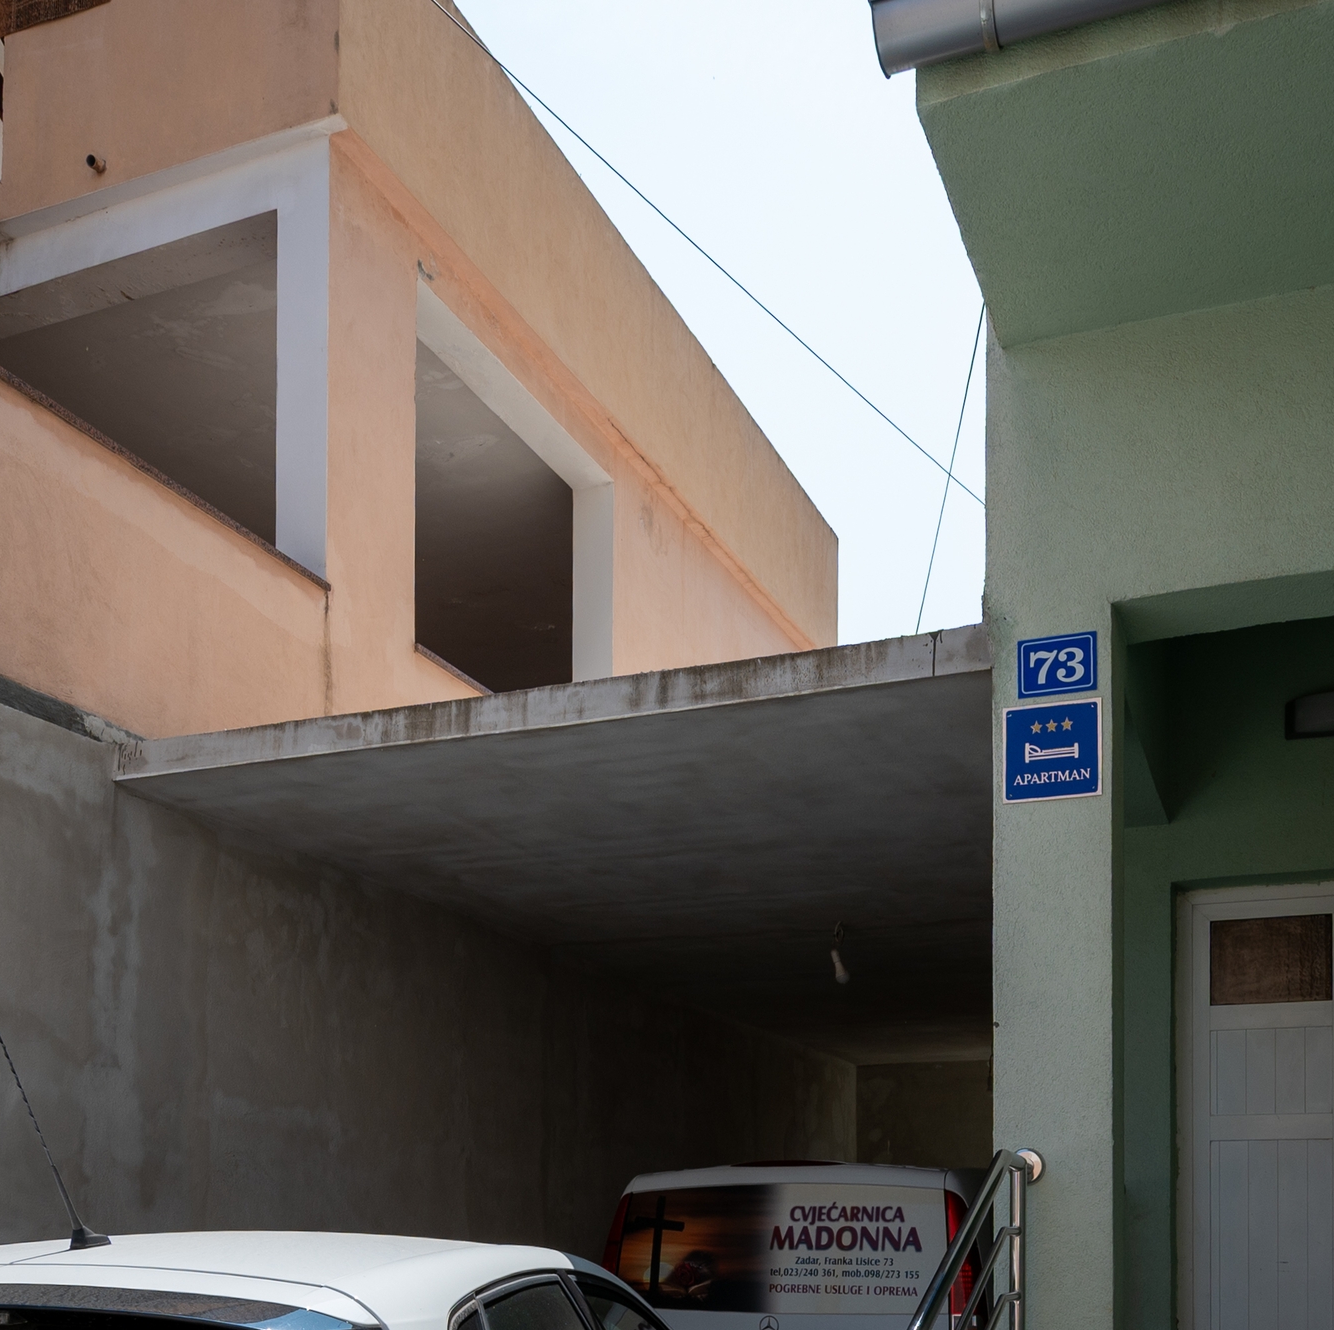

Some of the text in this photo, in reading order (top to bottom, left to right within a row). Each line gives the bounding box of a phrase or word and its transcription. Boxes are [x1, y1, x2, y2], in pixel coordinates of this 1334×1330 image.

[1029, 646, 1085, 685] 73
[1013, 767, 1091, 787] APARTMAN
[789, 1202, 906, 1225] CVJEĆARNICA
[769, 1225, 923, 1252] MADONNA
[795, 1256, 894, 1267] Zadar, Franka Lisice 73
[821, 1268, 839, 1279] 361,
[841, 1268, 901, 1280] mob.098/273
[904, 1270, 920, 1280] 155
[769, 1283, 822, 1294] POGREBNE
[824, 1285, 863, 1295] USLUGE
[873, 1285, 919, 1297] OPREMA
